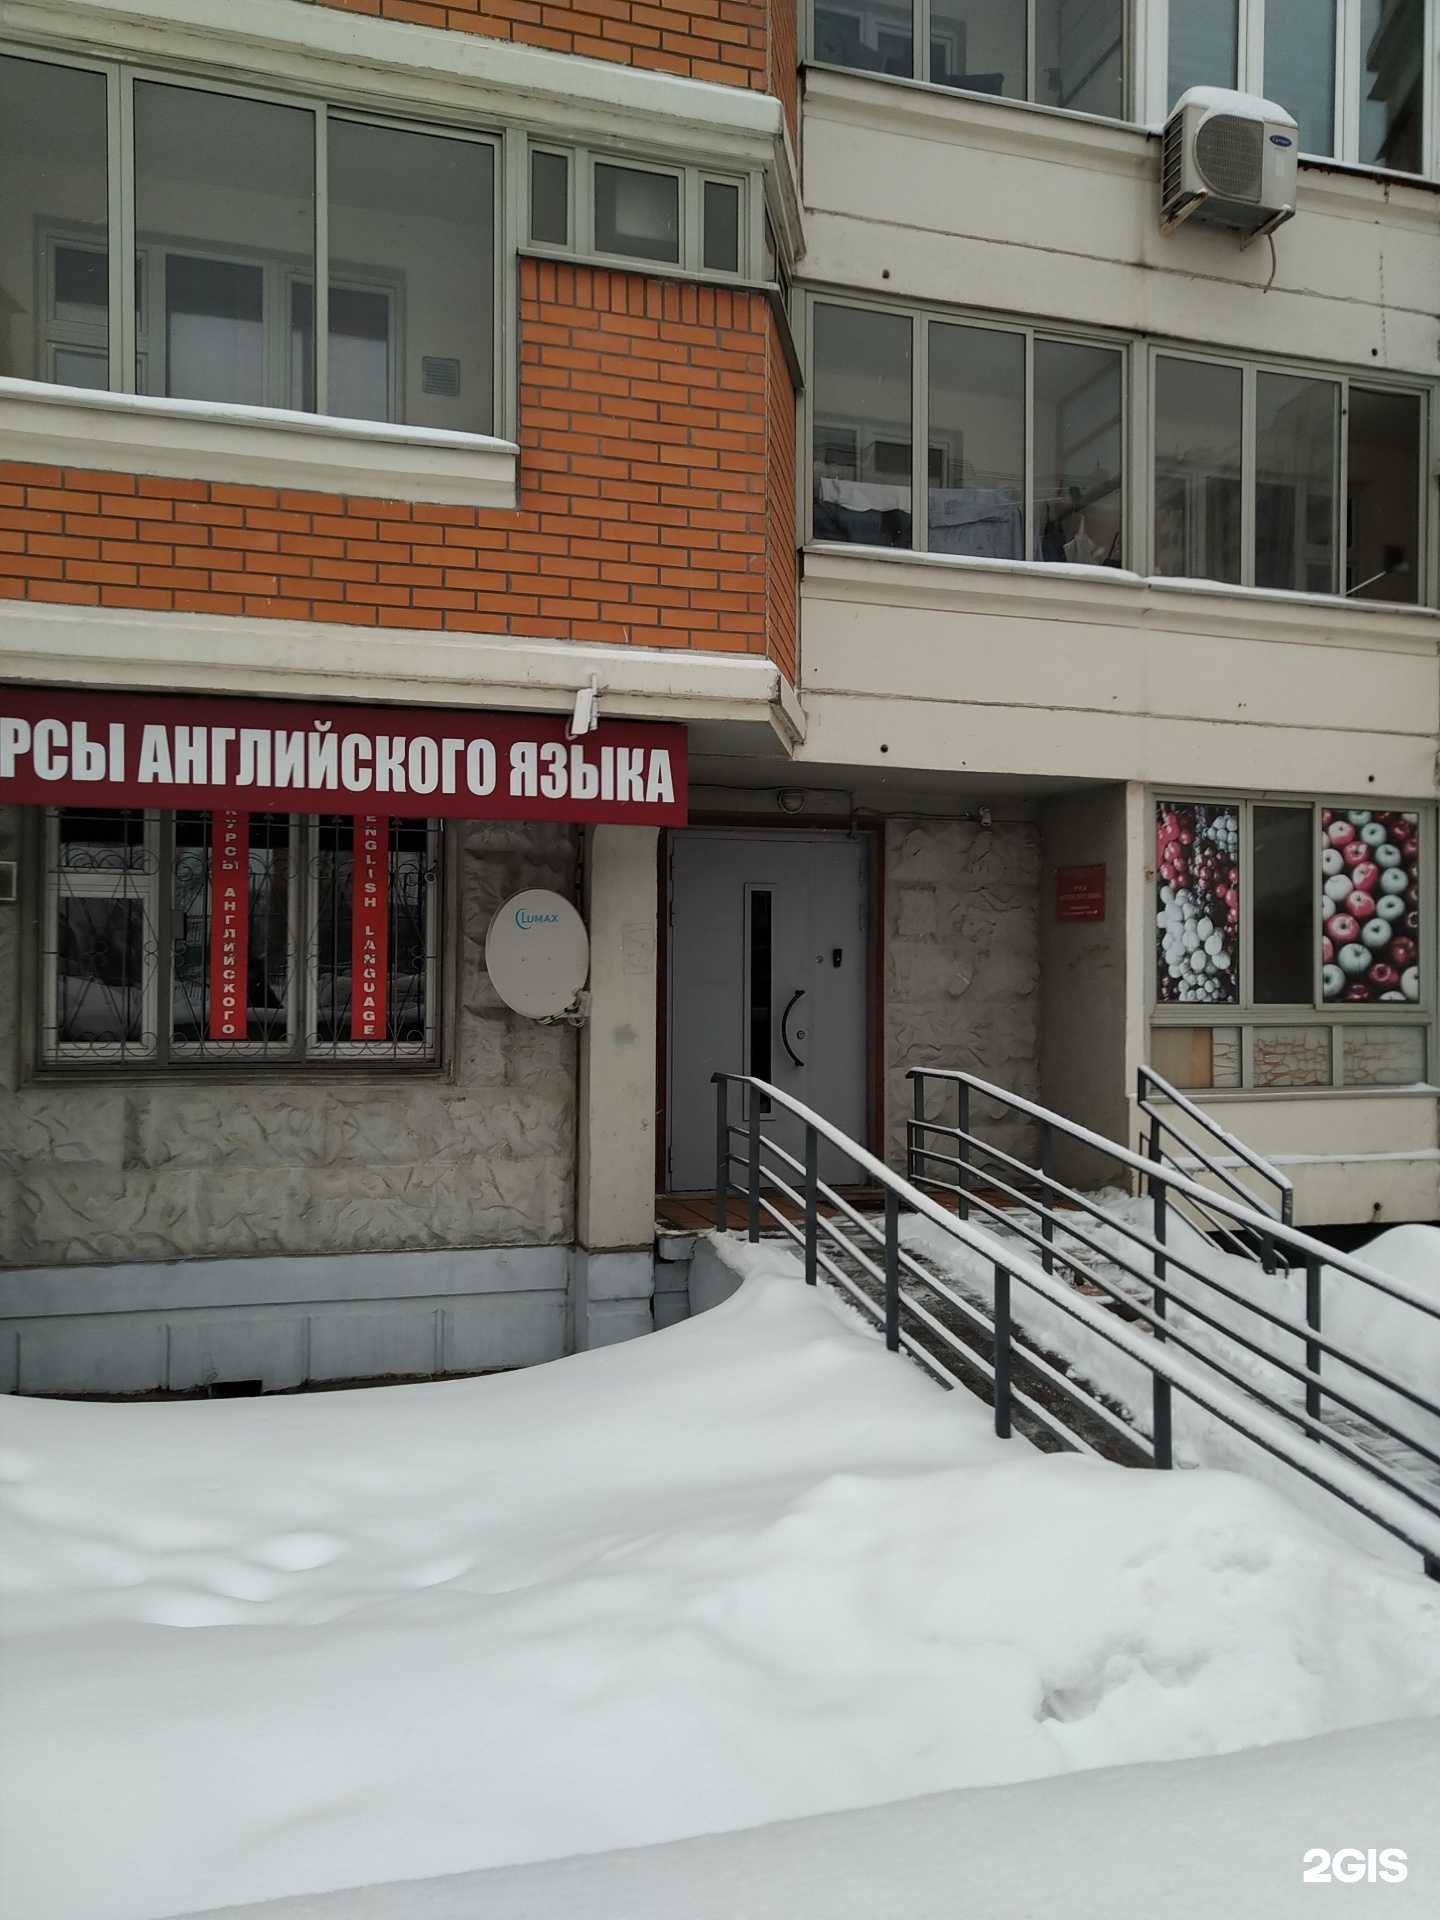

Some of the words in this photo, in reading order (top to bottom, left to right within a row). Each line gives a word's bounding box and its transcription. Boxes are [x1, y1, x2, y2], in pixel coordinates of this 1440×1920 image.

[0, 717, 125, 782] РСЫ
[137, 720, 497, 796] АНГЛИЙСКОГО
[509, 741, 676, 803] ЯЗЫКА
[364, 815, 377, 907] ENGLISH
[222, 887, 237, 1034] АНГЛИЙСКОГО
[363, 925, 377, 1035] LANGUAGE
